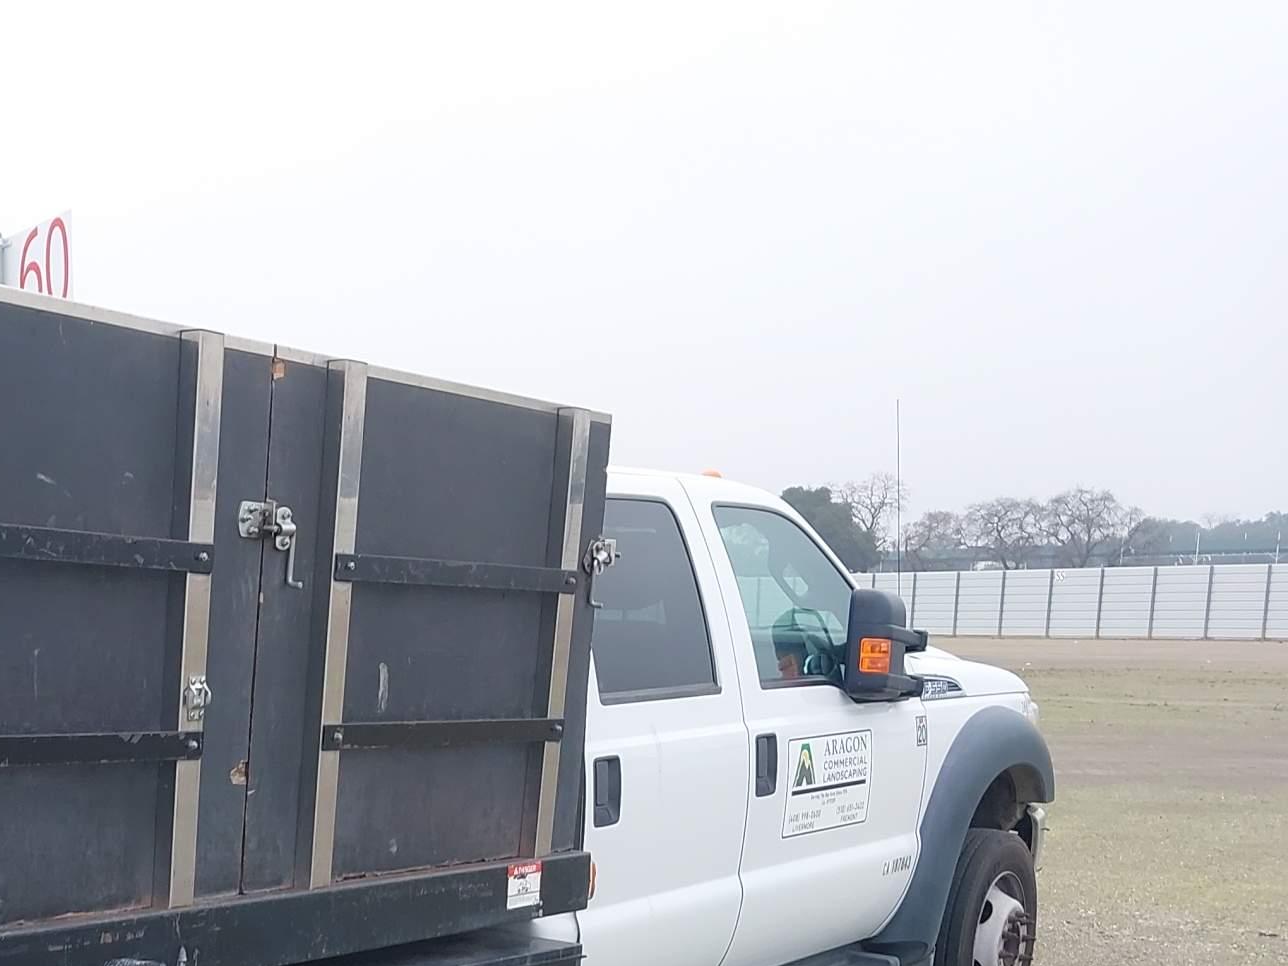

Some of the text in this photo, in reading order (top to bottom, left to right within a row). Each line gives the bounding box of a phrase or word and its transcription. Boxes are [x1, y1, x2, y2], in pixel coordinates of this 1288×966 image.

[824, 734, 867, 757] ARAGON
[824, 756, 868, 770] COMMERCIAL
[823, 767, 867, 784] LANDSCAPING
